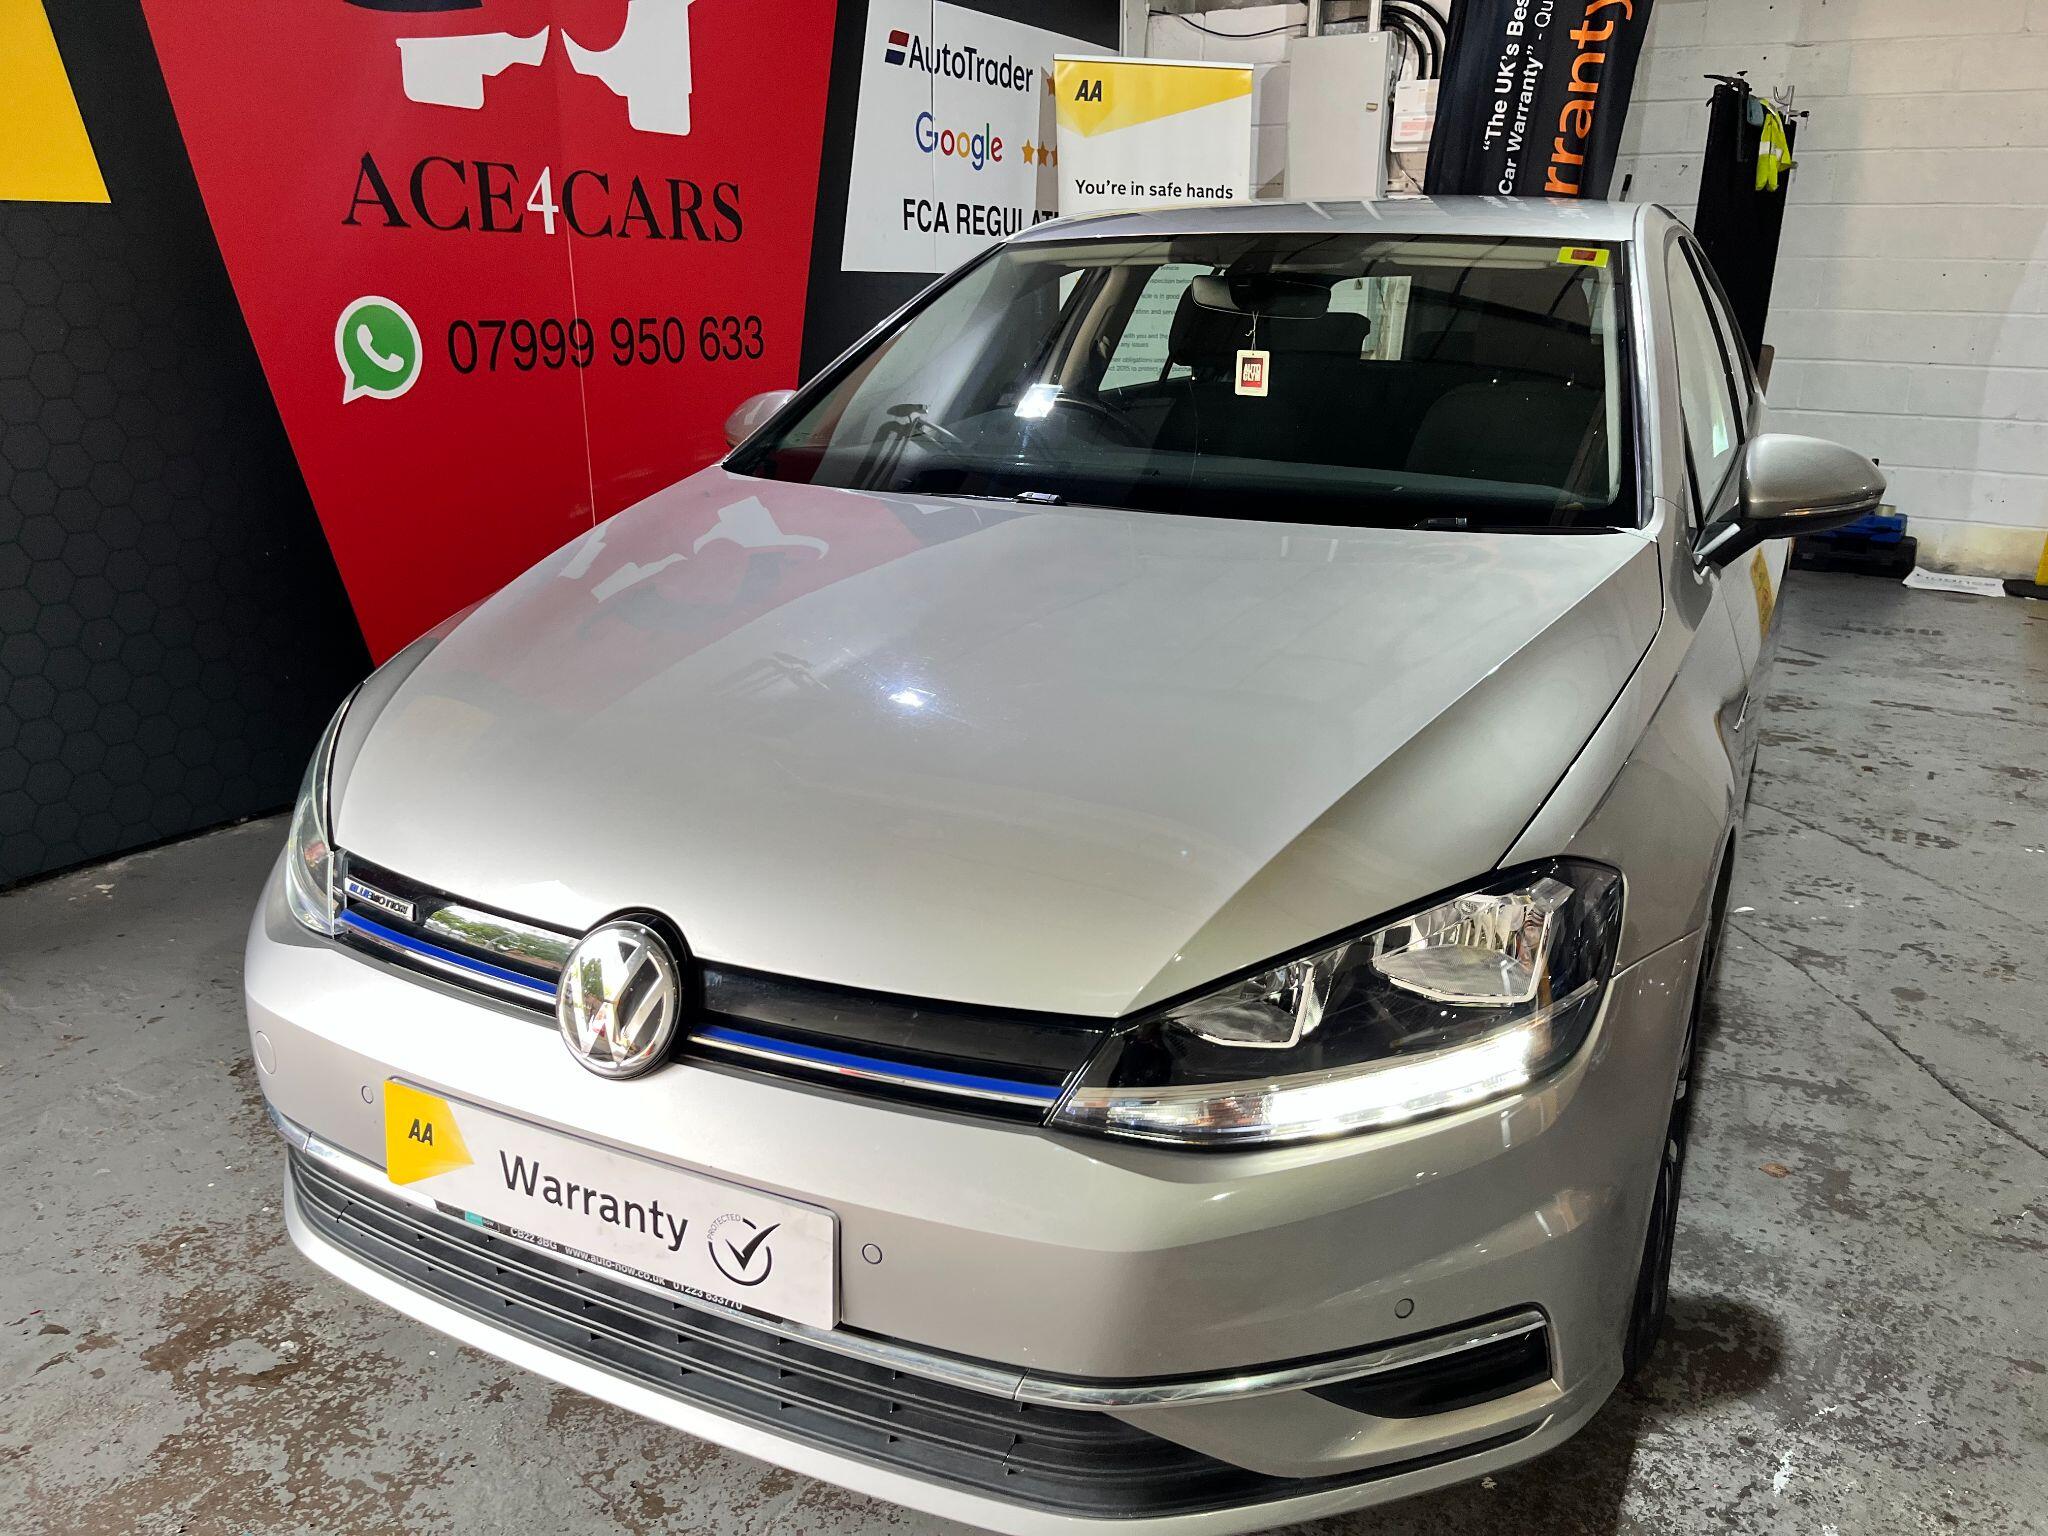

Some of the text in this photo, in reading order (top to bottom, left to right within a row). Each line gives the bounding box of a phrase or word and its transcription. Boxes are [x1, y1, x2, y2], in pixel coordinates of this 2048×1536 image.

[909, 35, 1034, 92] AutoTrader
[1074, 79, 1102, 102] AA
[915, 111, 1003, 171] Google
[1075, 179, 1233, 199] You're in safe hands
[1498, 158, 1517, 195] Car
[341, 151, 743, 243] ACE4CARS
[903, 198, 949, 234] FCA
[447, 316, 764, 374] 07999 950 633
[407, 1118, 434, 1147] AA
[499, 1150, 689, 1252] Warranty
[706, 1213, 741, 1241] PROTECTED
